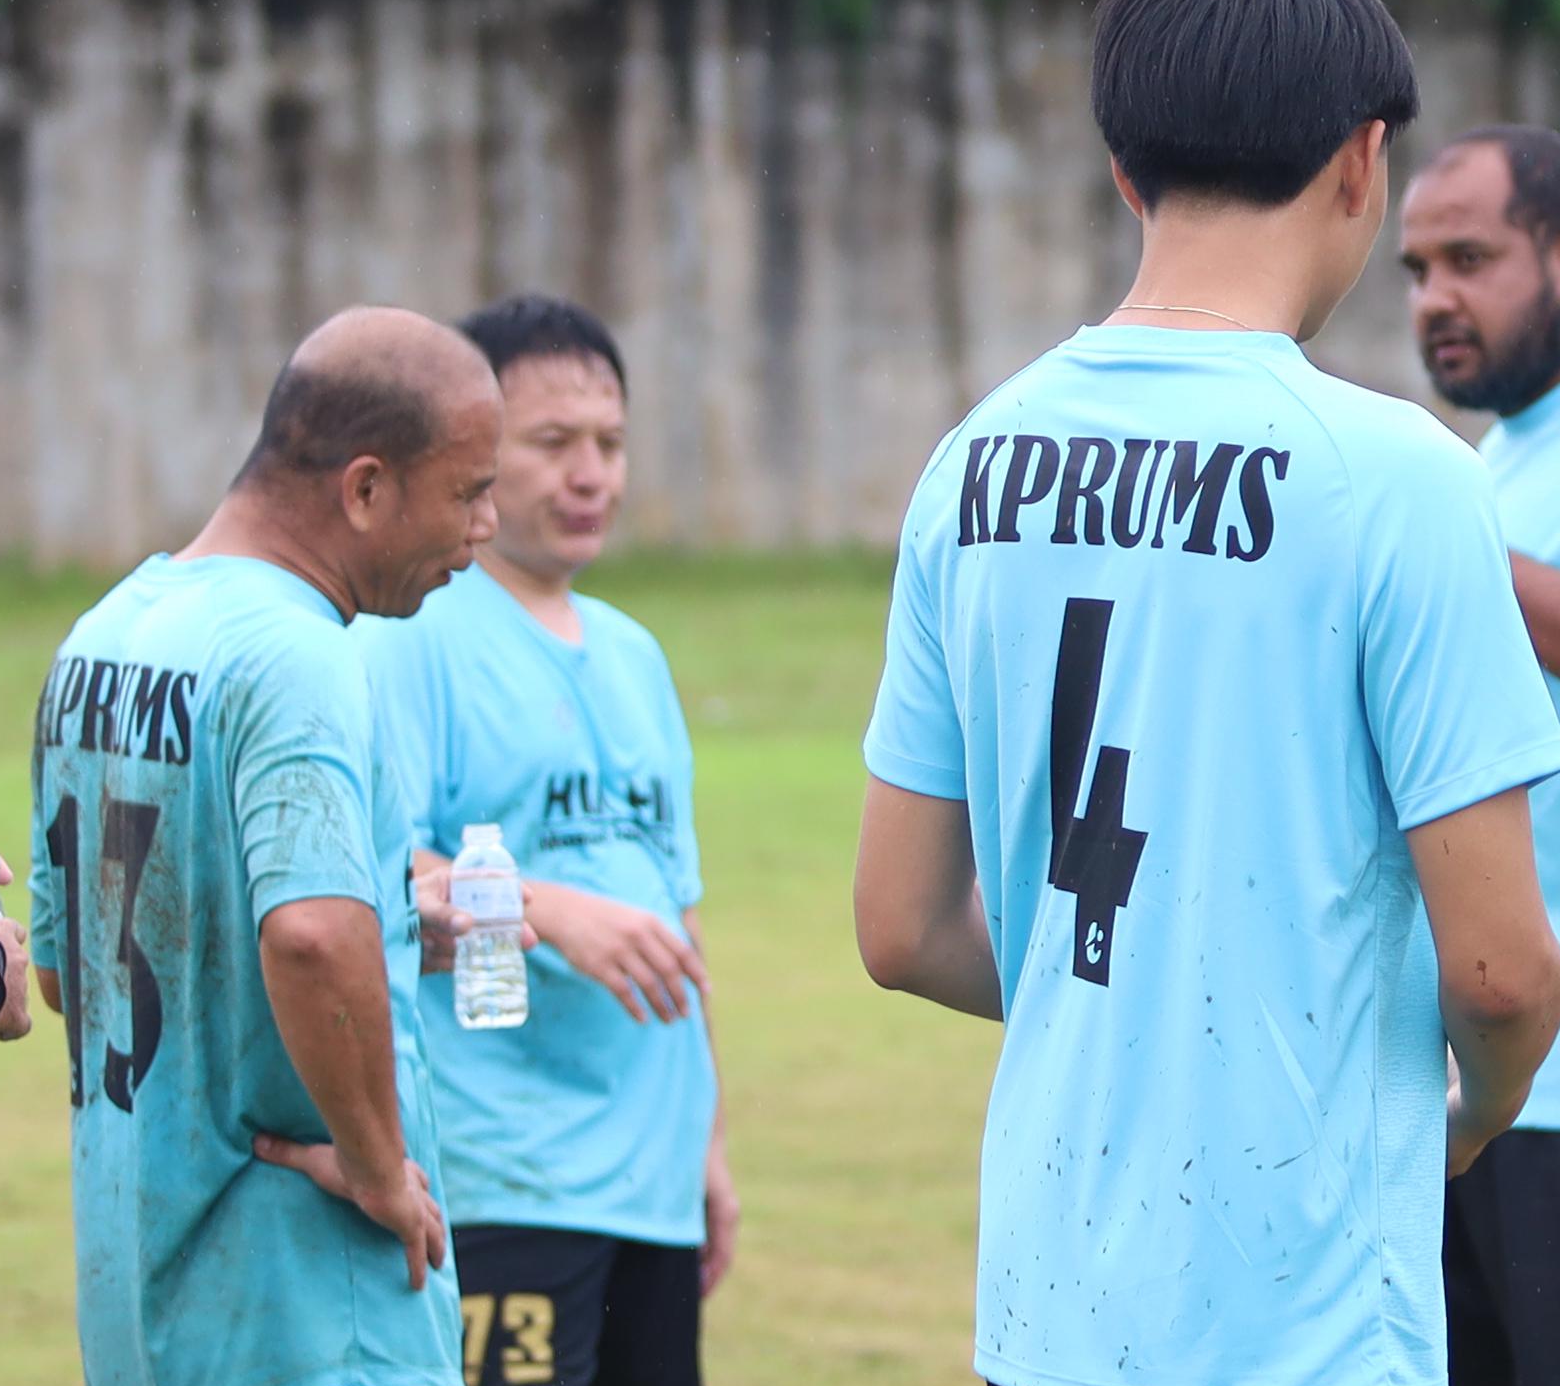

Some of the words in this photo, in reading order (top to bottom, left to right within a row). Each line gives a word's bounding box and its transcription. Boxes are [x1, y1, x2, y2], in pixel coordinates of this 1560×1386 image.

[957, 434, 1291, 563] KPRUMS
[39, 656, 198, 767] PRMS
[1047, 596, 1148, 988] 4
[45, 794, 162, 1115] 13
